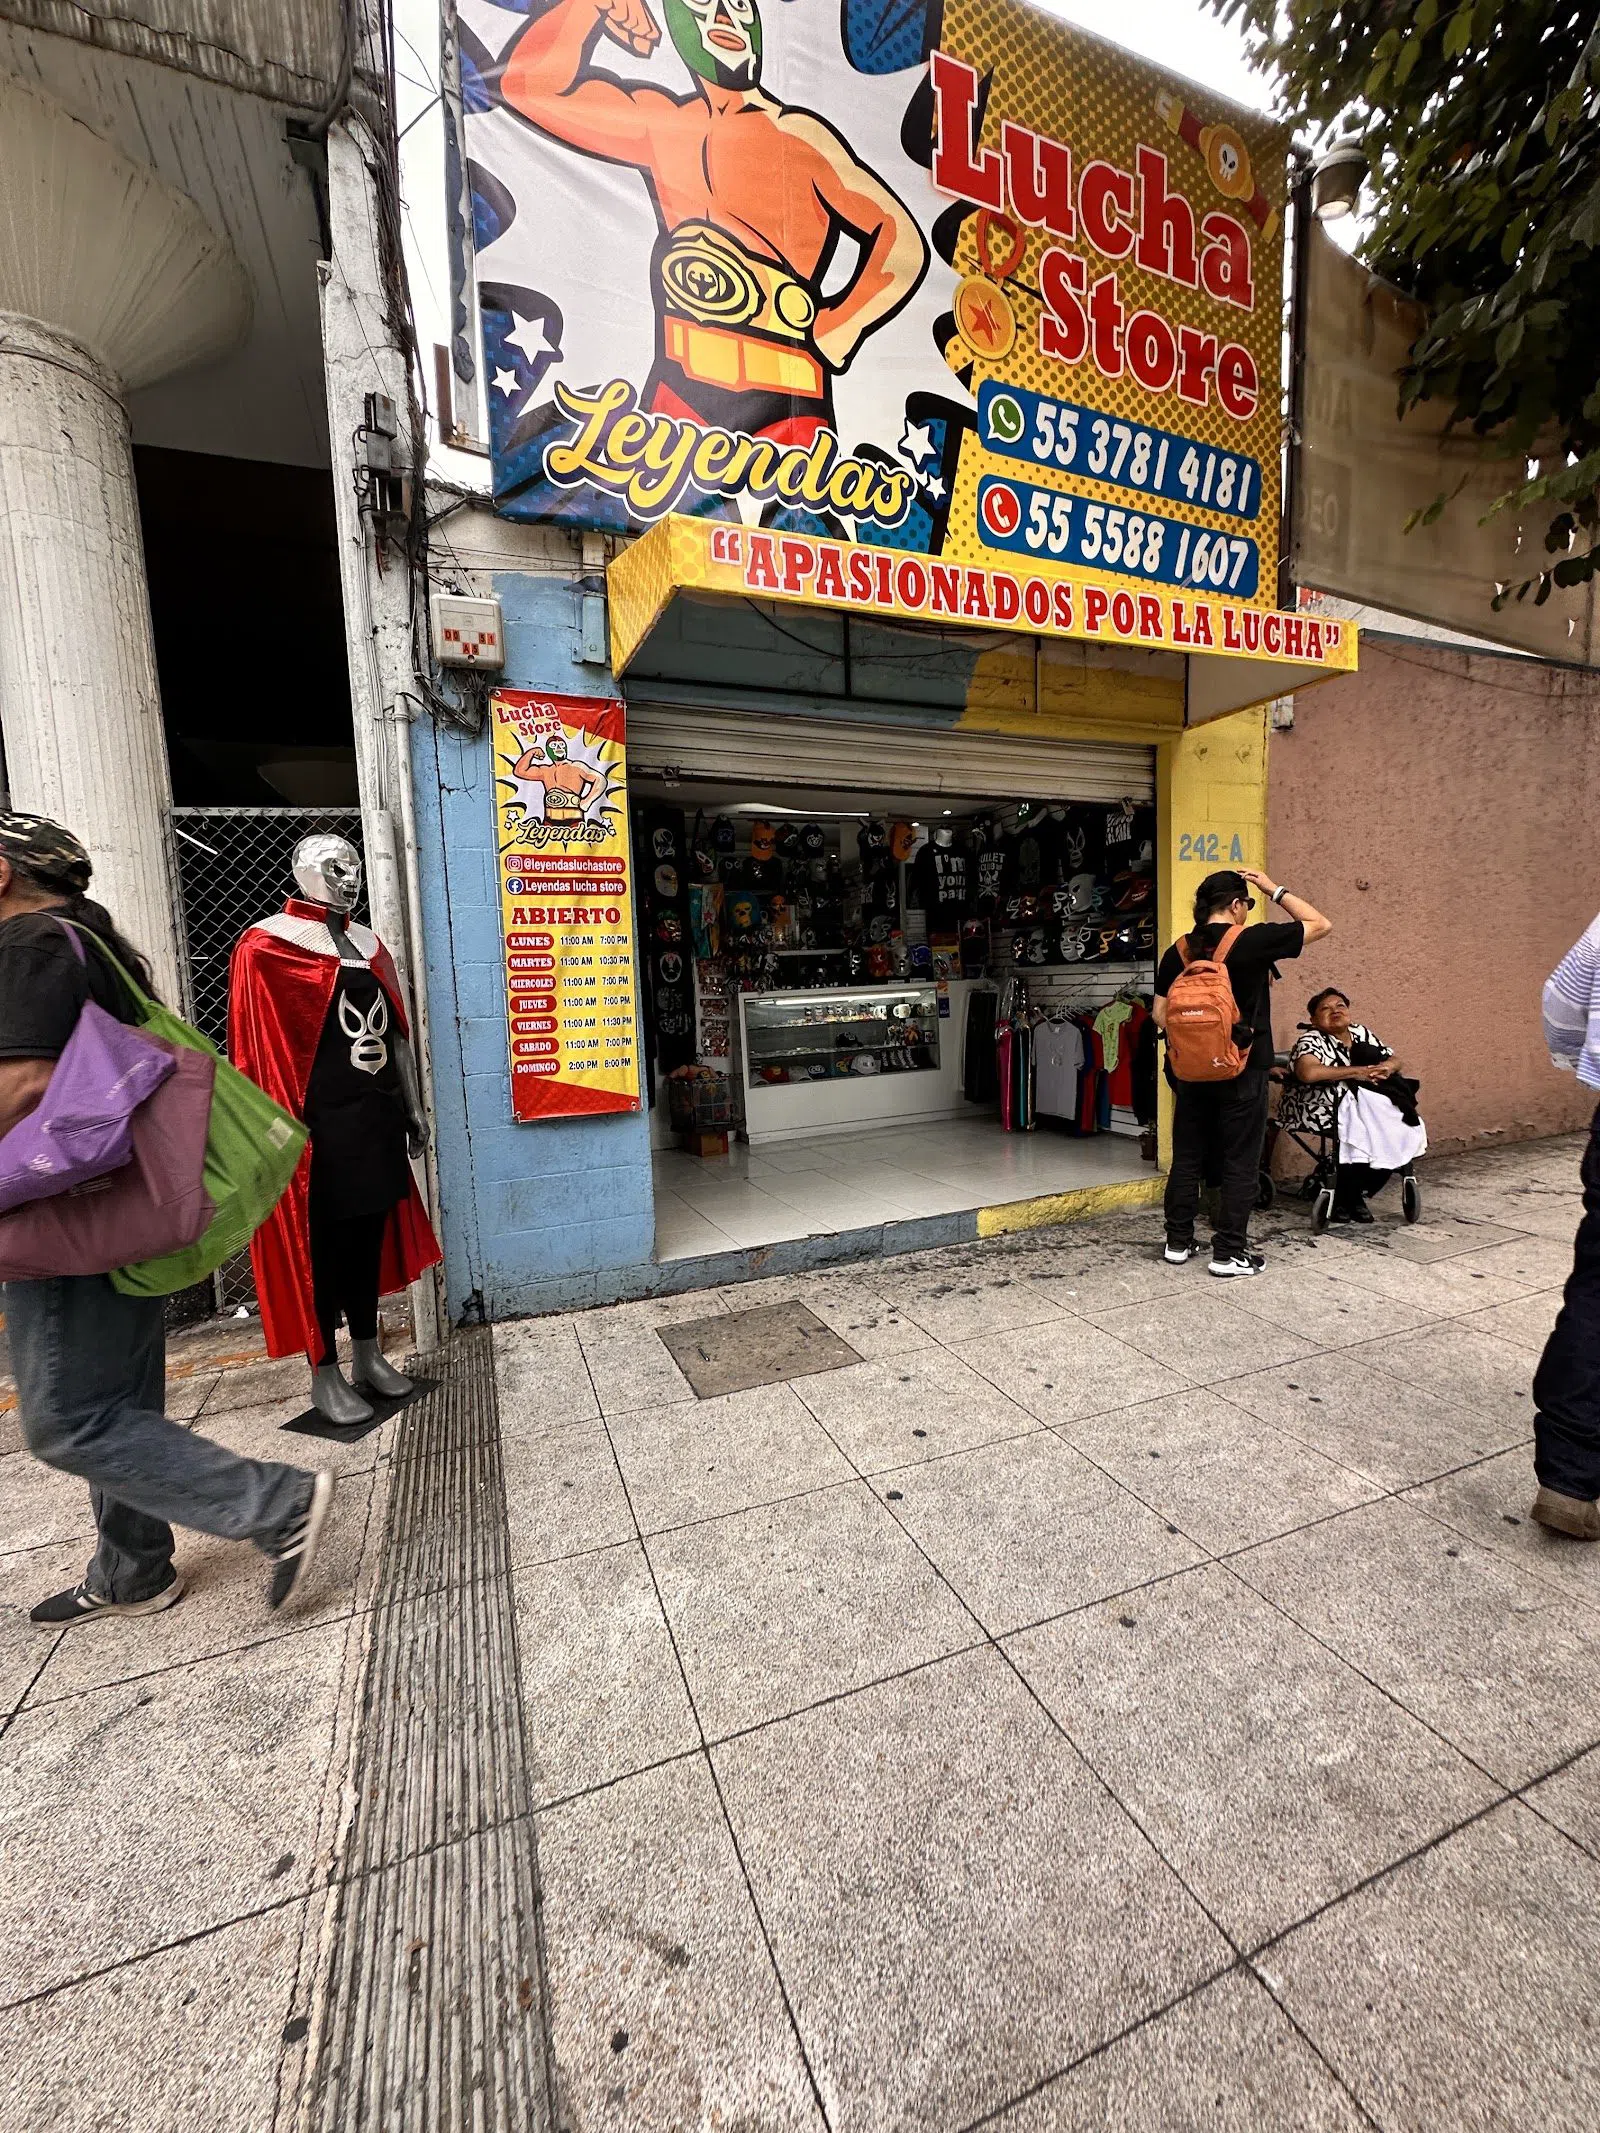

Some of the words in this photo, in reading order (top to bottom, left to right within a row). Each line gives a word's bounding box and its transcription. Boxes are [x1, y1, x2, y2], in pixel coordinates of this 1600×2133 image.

[930, 49, 1254, 309] Lucha
[1039, 246, 1260, 421] Store
[547, 380, 916, 519] Leyendas
[1033, 402, 1081, 466] 55
[1087, 419, 1168, 490] 3781
[1178, 449, 1254, 512] 4181
[1025, 493, 1070, 555] 55
[1081, 503, 1162, 574] 5588
[1175, 533, 1250, 590] 1607
[1085, 587, 1163, 639] POR
[1172, 602, 1219, 648] LA
[497, 701, 557, 723] Lucha
[518, 720, 561, 737] Store
[516, 820, 606, 848] Leyendas
[1179, 833, 1243, 862] 242-A
[524, 858, 622, 871] @leyendasluchastore
[525, 880, 570, 894] Leyendas
[573, 881, 597, 892] lucha
[600, 882, 623, 893] store
[511, 907, 621, 924] ABIERTO
[511, 936, 550, 946] LUNES
[560, 936, 579, 945] 11:00
[581, 936, 593, 945] AM
[600, 936, 615, 944] 7:00
[617, 935, 628, 944] PM
[511, 957, 552, 967] MARTES
[560, 957, 579, 966] 11:00
[581, 957, 592, 965] AM
[600, 956, 617, 965] 10:30
[619, 956, 630, 965] PM
[511, 978, 553, 988] MIERCOLES
[563, 978, 582, 986] 11:00
[584, 977, 595, 986] AM
[602, 977, 617, 985] 7:00
[618, 976, 628, 985] PM
[519, 999, 547, 1010] JUEVES
[563, 998, 583, 1007] 11:00
[585, 997, 596, 1006] AM
[603, 997, 618, 1005] 7:00
[620, 996, 630, 1004] PM
[517, 1020, 551, 1031] VIERNES
[563, 1019, 582, 1028] 11:00
[584, 1018, 595, 1027] AM
[602, 1018, 621, 1026] 11:30
[622, 1017, 632, 1025] PM
[519, 1042, 551, 1052] SABADO
[565, 1040, 585, 1049] 11:00
[587, 1039, 599, 1048] AM
[605, 1038, 620, 1047] 7:00
[621, 1038, 632, 1046] PM
[517, 1063, 556, 1073] DOMINGO
[569, 1062, 585, 1070] 2:00
[587, 1060, 598, 1069] PM
[621, 1058, 631, 1066] PM
